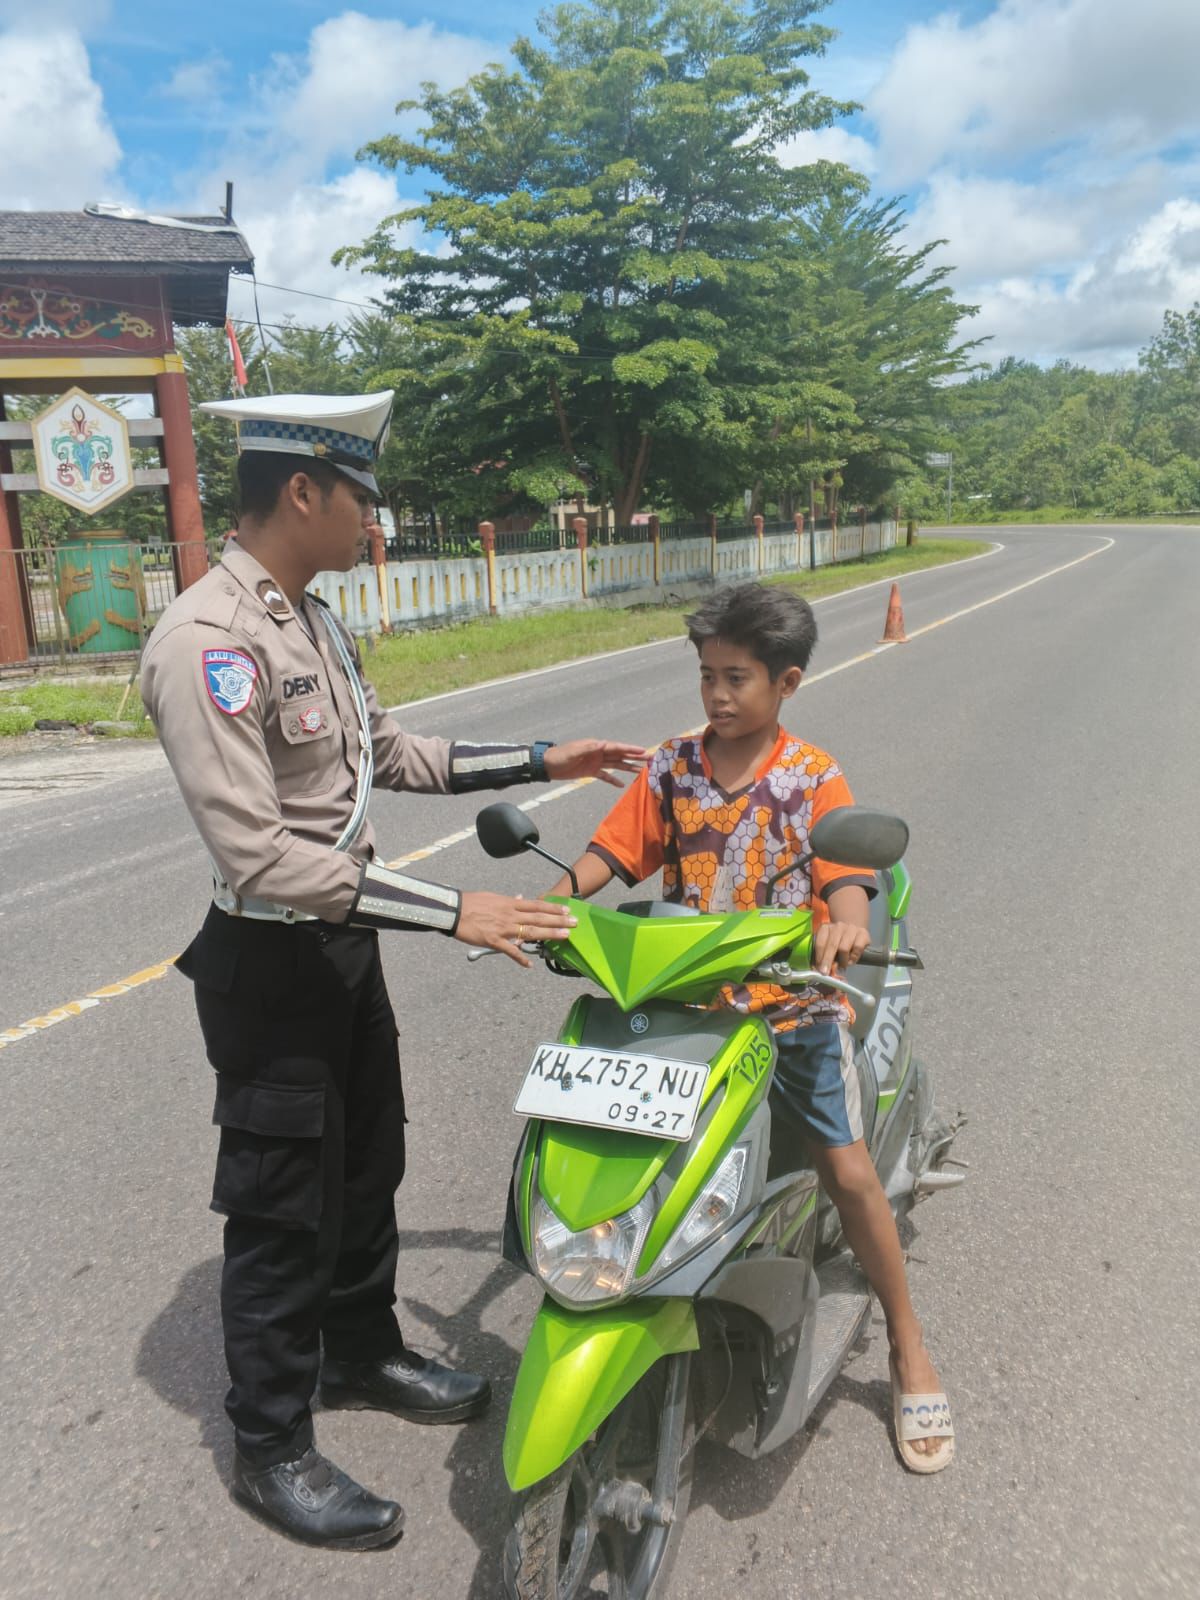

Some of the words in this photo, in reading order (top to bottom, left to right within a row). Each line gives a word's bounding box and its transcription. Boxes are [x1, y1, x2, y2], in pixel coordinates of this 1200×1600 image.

[283, 674, 320, 698] DENY
[531, 1049, 571, 1083] KH
[575, 1056, 648, 1091] 4752
[658, 1066, 699, 1099] NU
[733, 1034, 771, 1085] 125
